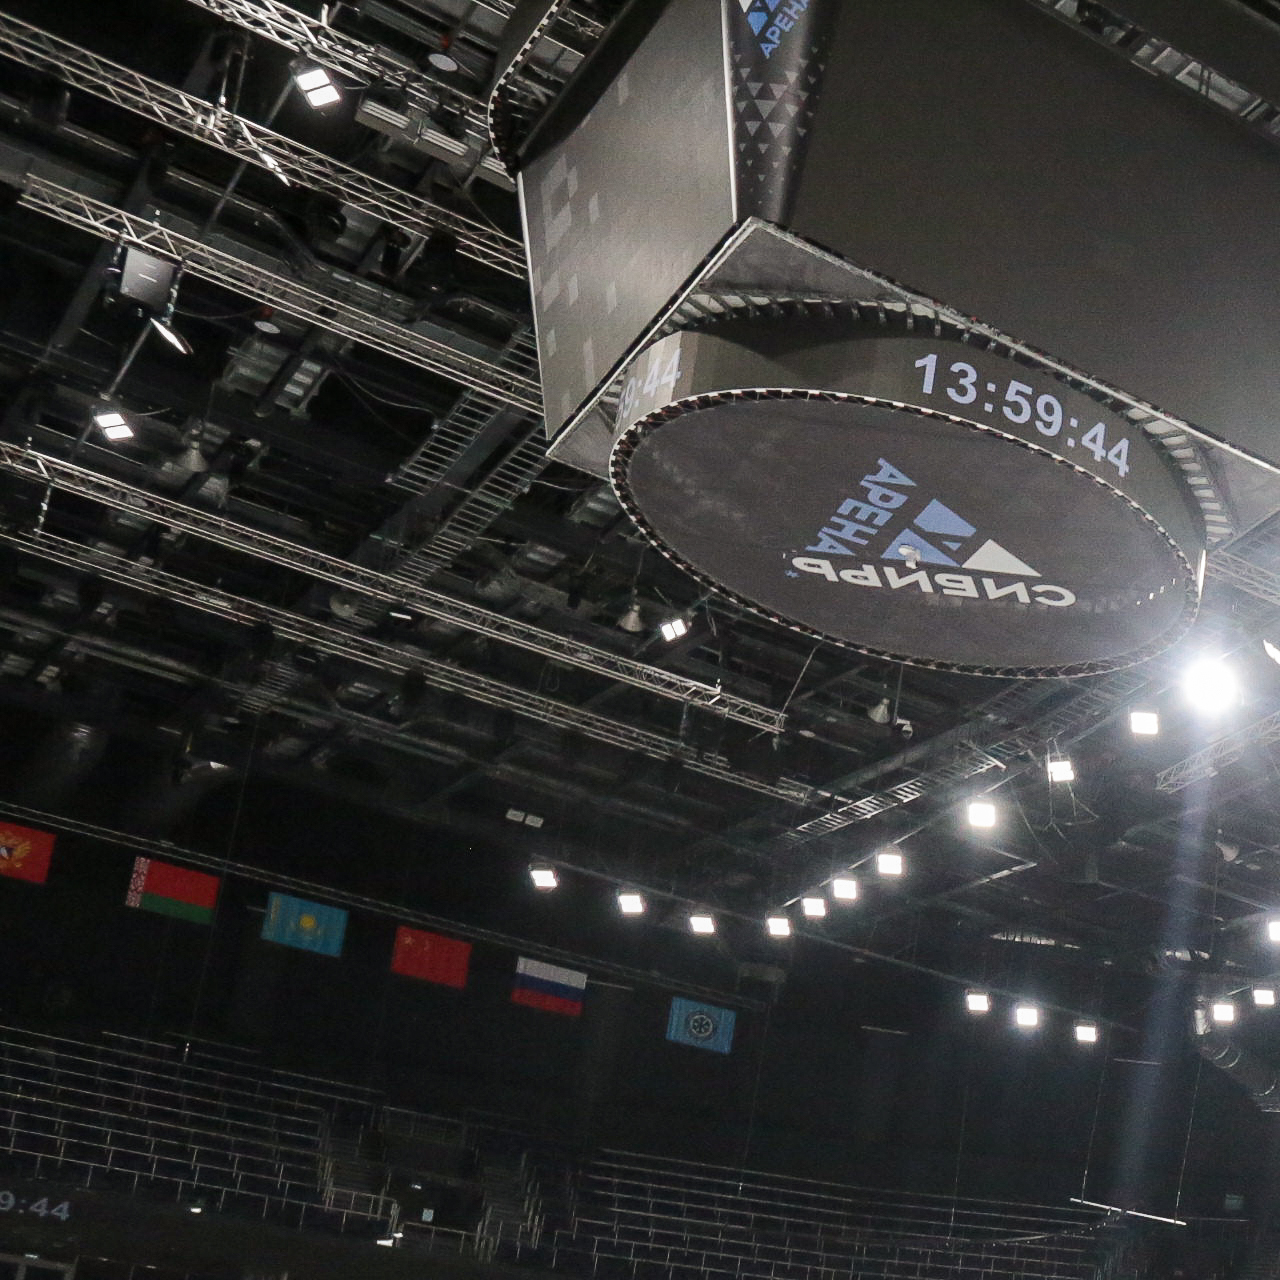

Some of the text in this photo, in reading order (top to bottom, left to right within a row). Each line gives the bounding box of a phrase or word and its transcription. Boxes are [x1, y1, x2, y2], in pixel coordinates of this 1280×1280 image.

[760, 0, 808, 59] АРЕН
[915, 353, 1130, 477] 13:59:44
[805, 457, 917, 556] АРЕНА
[791, 555, 1077, 607] СИБИРЬ
